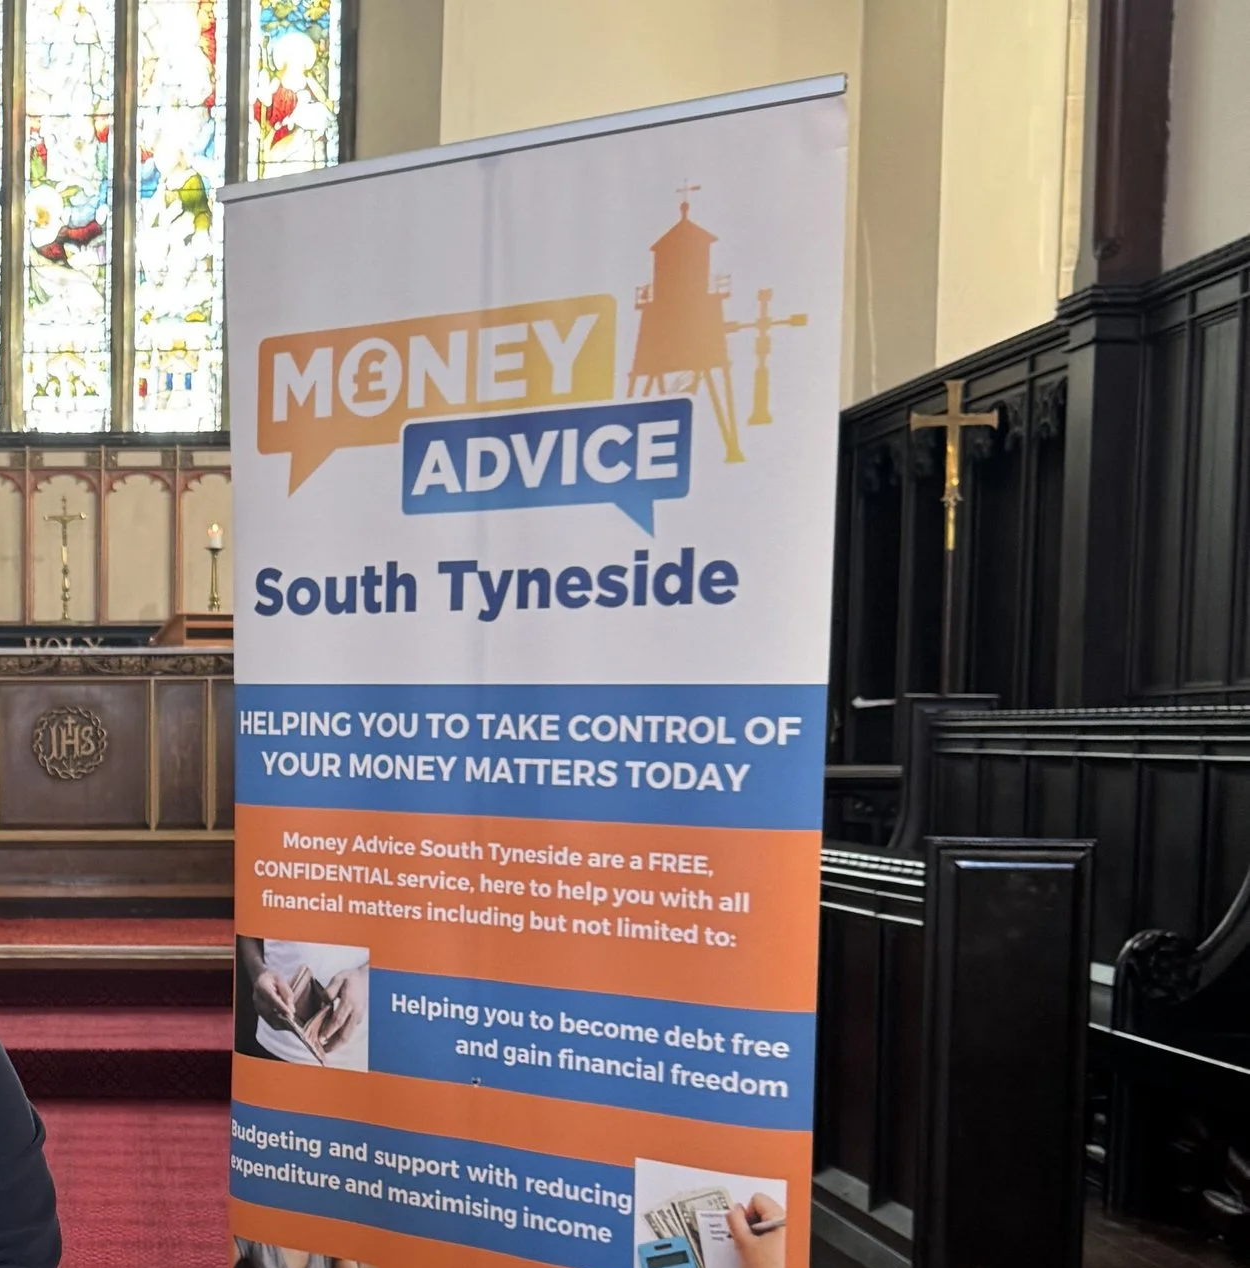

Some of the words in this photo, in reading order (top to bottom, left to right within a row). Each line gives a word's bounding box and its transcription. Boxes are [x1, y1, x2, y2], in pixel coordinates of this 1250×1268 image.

[272, 313, 600, 424] MONEY
[411, 420, 679, 496] ADVICE
[254, 560, 417, 617] South
[438, 547, 739, 622] Tyneside
[240, 710, 351, 736] HELPING
[359, 713, 418, 738] YOU
[426, 713, 470, 740] TO
[477, 714, 560, 741] TAKE
[568, 714, 736, 744] CONTROL
[745, 716, 802, 745] OF
[262, 752, 341, 778] YOUR
[349, 753, 456, 781] MONEY
[465, 757, 618, 787] MATTERS
[626, 761, 750, 791] TODAY
[283, 832, 348, 855] Money
[352, 835, 415, 856] Advice
[420, 839, 483, 860] South
[489, 843, 582, 866] Tyneside
[588, 852, 625, 869] are
[629, 854, 642, 870] a
[648, 852, 714, 877] FREE,
[254, 860, 393, 886] CONFIDENTIAL
[397, 871, 475, 893] service,
[480, 875, 525, 897] here
[530, 879, 551, 897] to
[557, 880, 607, 906] help
[612, 888, 654, 908] you
[660, 888, 713, 911] with
[719, 892, 750, 913] all
[262, 890, 343, 912] financial
[348, 900, 422, 920] matters
[427, 902, 524, 932] including
[530, 911, 567, 932] but
[572, 918, 611, 936] not
[617, 918, 698, 944] limited
[704, 927, 737, 947] to:
[391, 993, 479, 1024] Helping
[484, 1009, 524, 1028] you
[529, 1013, 554, 1030] to
[559, 1012, 659, 1044] become
[664, 1025, 725, 1053] debt
[731, 1034, 791, 1059] free
[455, 1038, 498, 1059] and
[503, 1044, 552, 1067] gain
[557, 1048, 664, 1083] financial
[670, 1064, 788, 1098] freedom
[231, 1154, 340, 1190] expenditure
[345, 1177, 382, 1199] and
[388, 1185, 516, 1229] maximising
[523, 1206, 612, 1243] income
[232, 1119, 321, 1157] Budgeting
[329, 1142, 367, 1162] and
[374, 1150, 459, 1178] support
[466, 1163, 517, 1189] with
[525, 1177, 633, 1215] reducing
